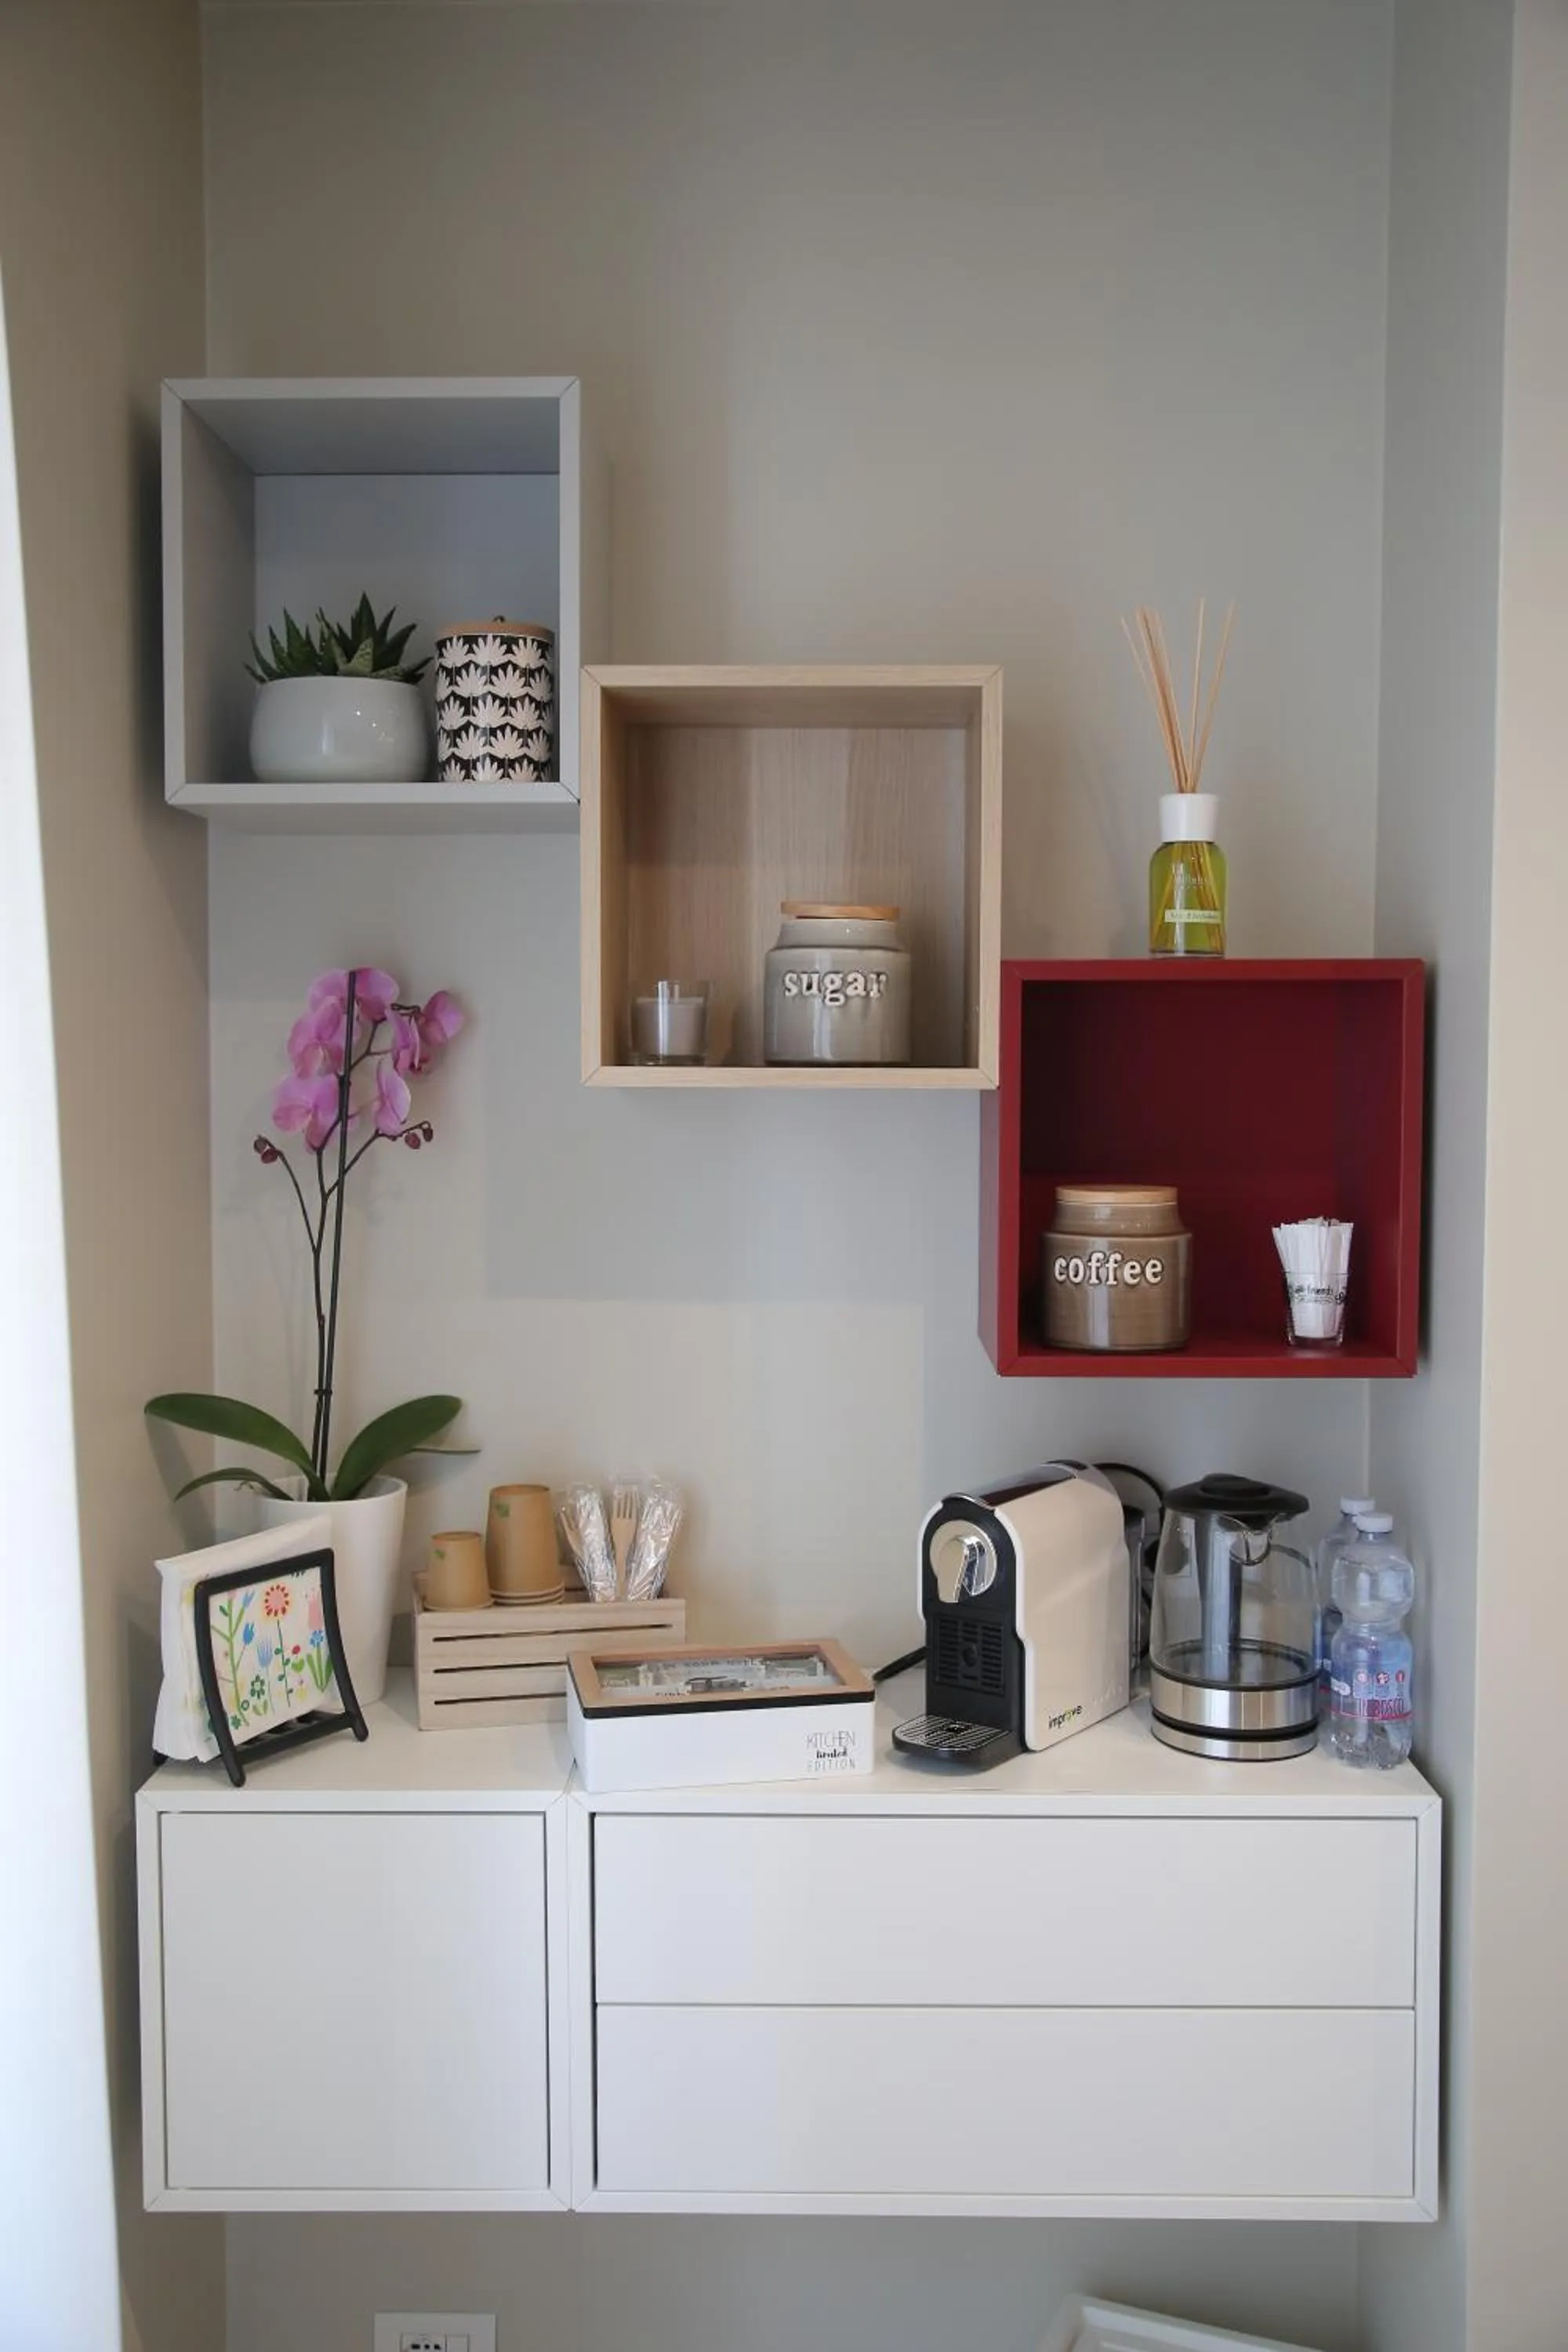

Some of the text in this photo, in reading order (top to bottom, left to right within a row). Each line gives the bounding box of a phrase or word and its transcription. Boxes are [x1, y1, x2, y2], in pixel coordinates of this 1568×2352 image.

[785, 971, 887, 1006] sugar
[1054, 1252, 1163, 1285] coffee
[1048, 1705, 1083, 1729] improve
[806, 1730, 855, 1749] KITCHEN
